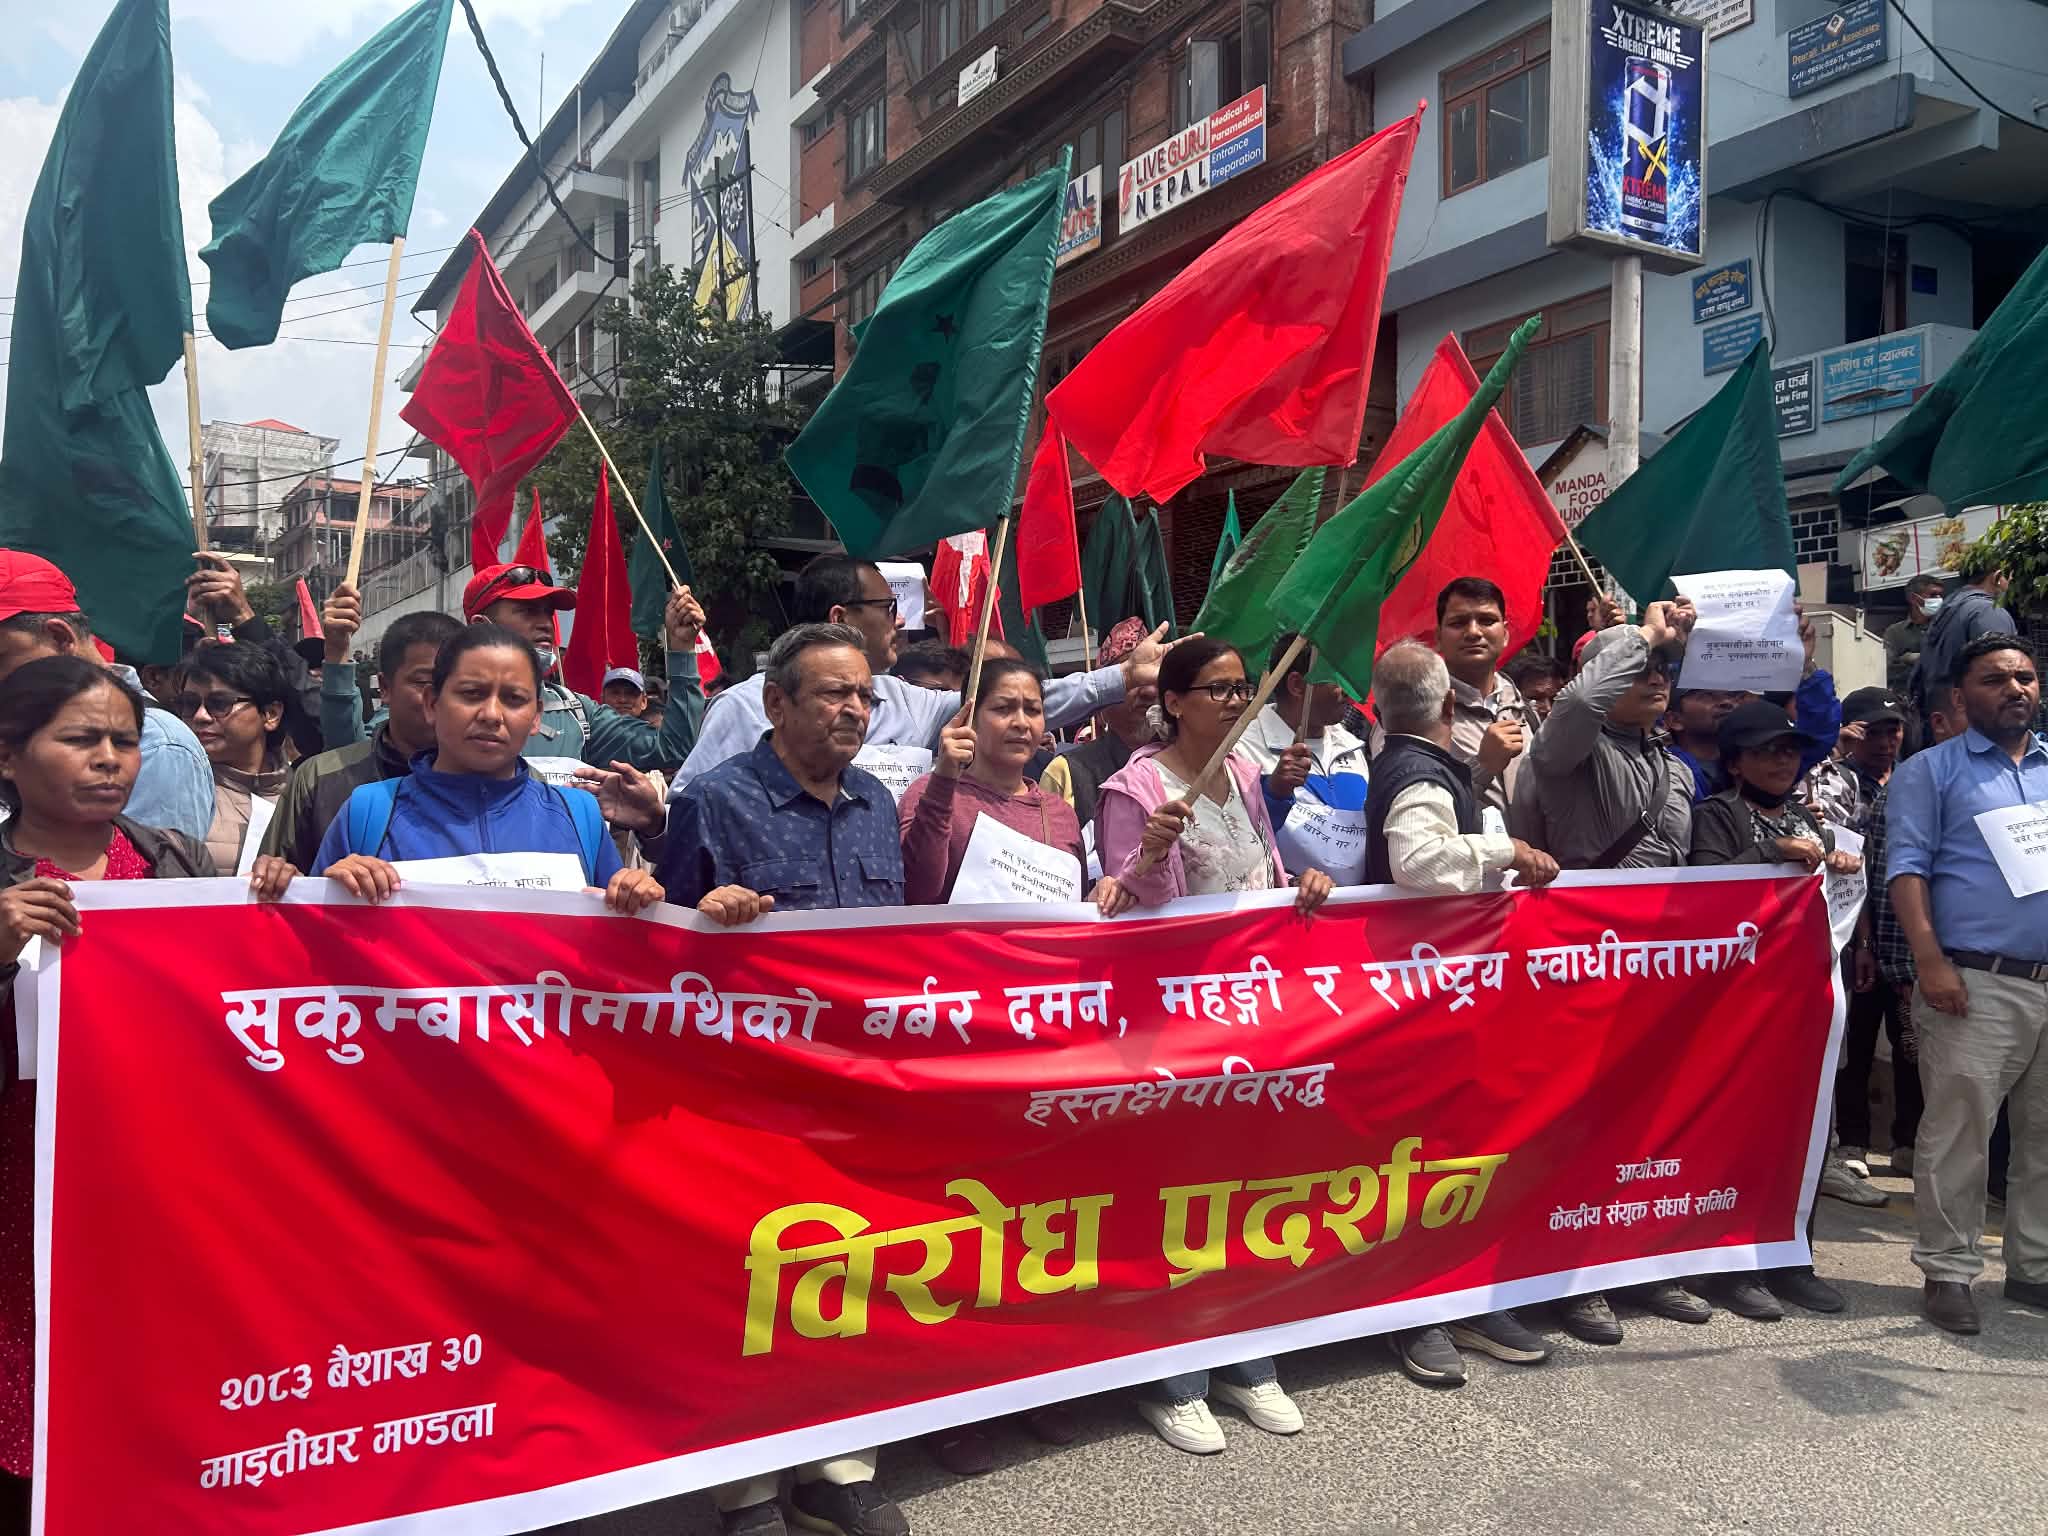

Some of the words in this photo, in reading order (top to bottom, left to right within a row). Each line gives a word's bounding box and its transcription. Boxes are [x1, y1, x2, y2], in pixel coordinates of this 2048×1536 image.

[1612, 5, 1680, 52] XTREME
[1618, 35, 1648, 57] ENERGY
[1651, 46, 1676, 66] DRINK
[1211, 102, 1242, 129] Medical
[1243, 100, 1250, 111] &
[1211, 108, 1263, 143] Paramedical
[1212, 137, 1249, 164] Entrance
[1212, 148, 1261, 180] Preparation
[1065, 175, 1096, 209] AL
[1136, 160, 1208, 219] NEPAL
[1062, 204, 1096, 238] UTE
[1776, 394, 1790, 404] Law
[1792, 389, 1808, 401] Firm
[1788, 372, 1808, 388] फर्म
[1556, 472, 1606, 495] MANDA
[222, 971, 832, 1072] सुकुम्बासीमाथिको
[863, 976, 980, 1045] बर्बर
[1003, 981, 1126, 1039] दमन,
[1157, 955, 1282, 1026] महङ्गी
[1304, 966, 1343, 1016] र
[1361, 942, 1509, 1012] राष्ट्रिय
[1024, 1055, 1334, 1127] हस्तक्षेपविरुद्ध
[1616, 1157, 1682, 1184] आयोजक
[1549, 1203, 1602, 1231] केन्द्रीय
[1605, 1200, 1649, 1227] संयुक्त
[1653, 1192, 1691, 1219] संघर्ष
[1694, 1187, 1739, 1215] समिति
[742, 1179, 1113, 1357] विरोध
[1160, 1137, 1508, 1290] प्रदर्शन
[219, 1363, 313, 1411] २०८३
[327, 1344, 432, 1388] बैशाख
[440, 1333, 482, 1372] ३०
[200, 1428, 363, 1489] माइतीघर
[373, 1402, 497, 1454] मण्डला
